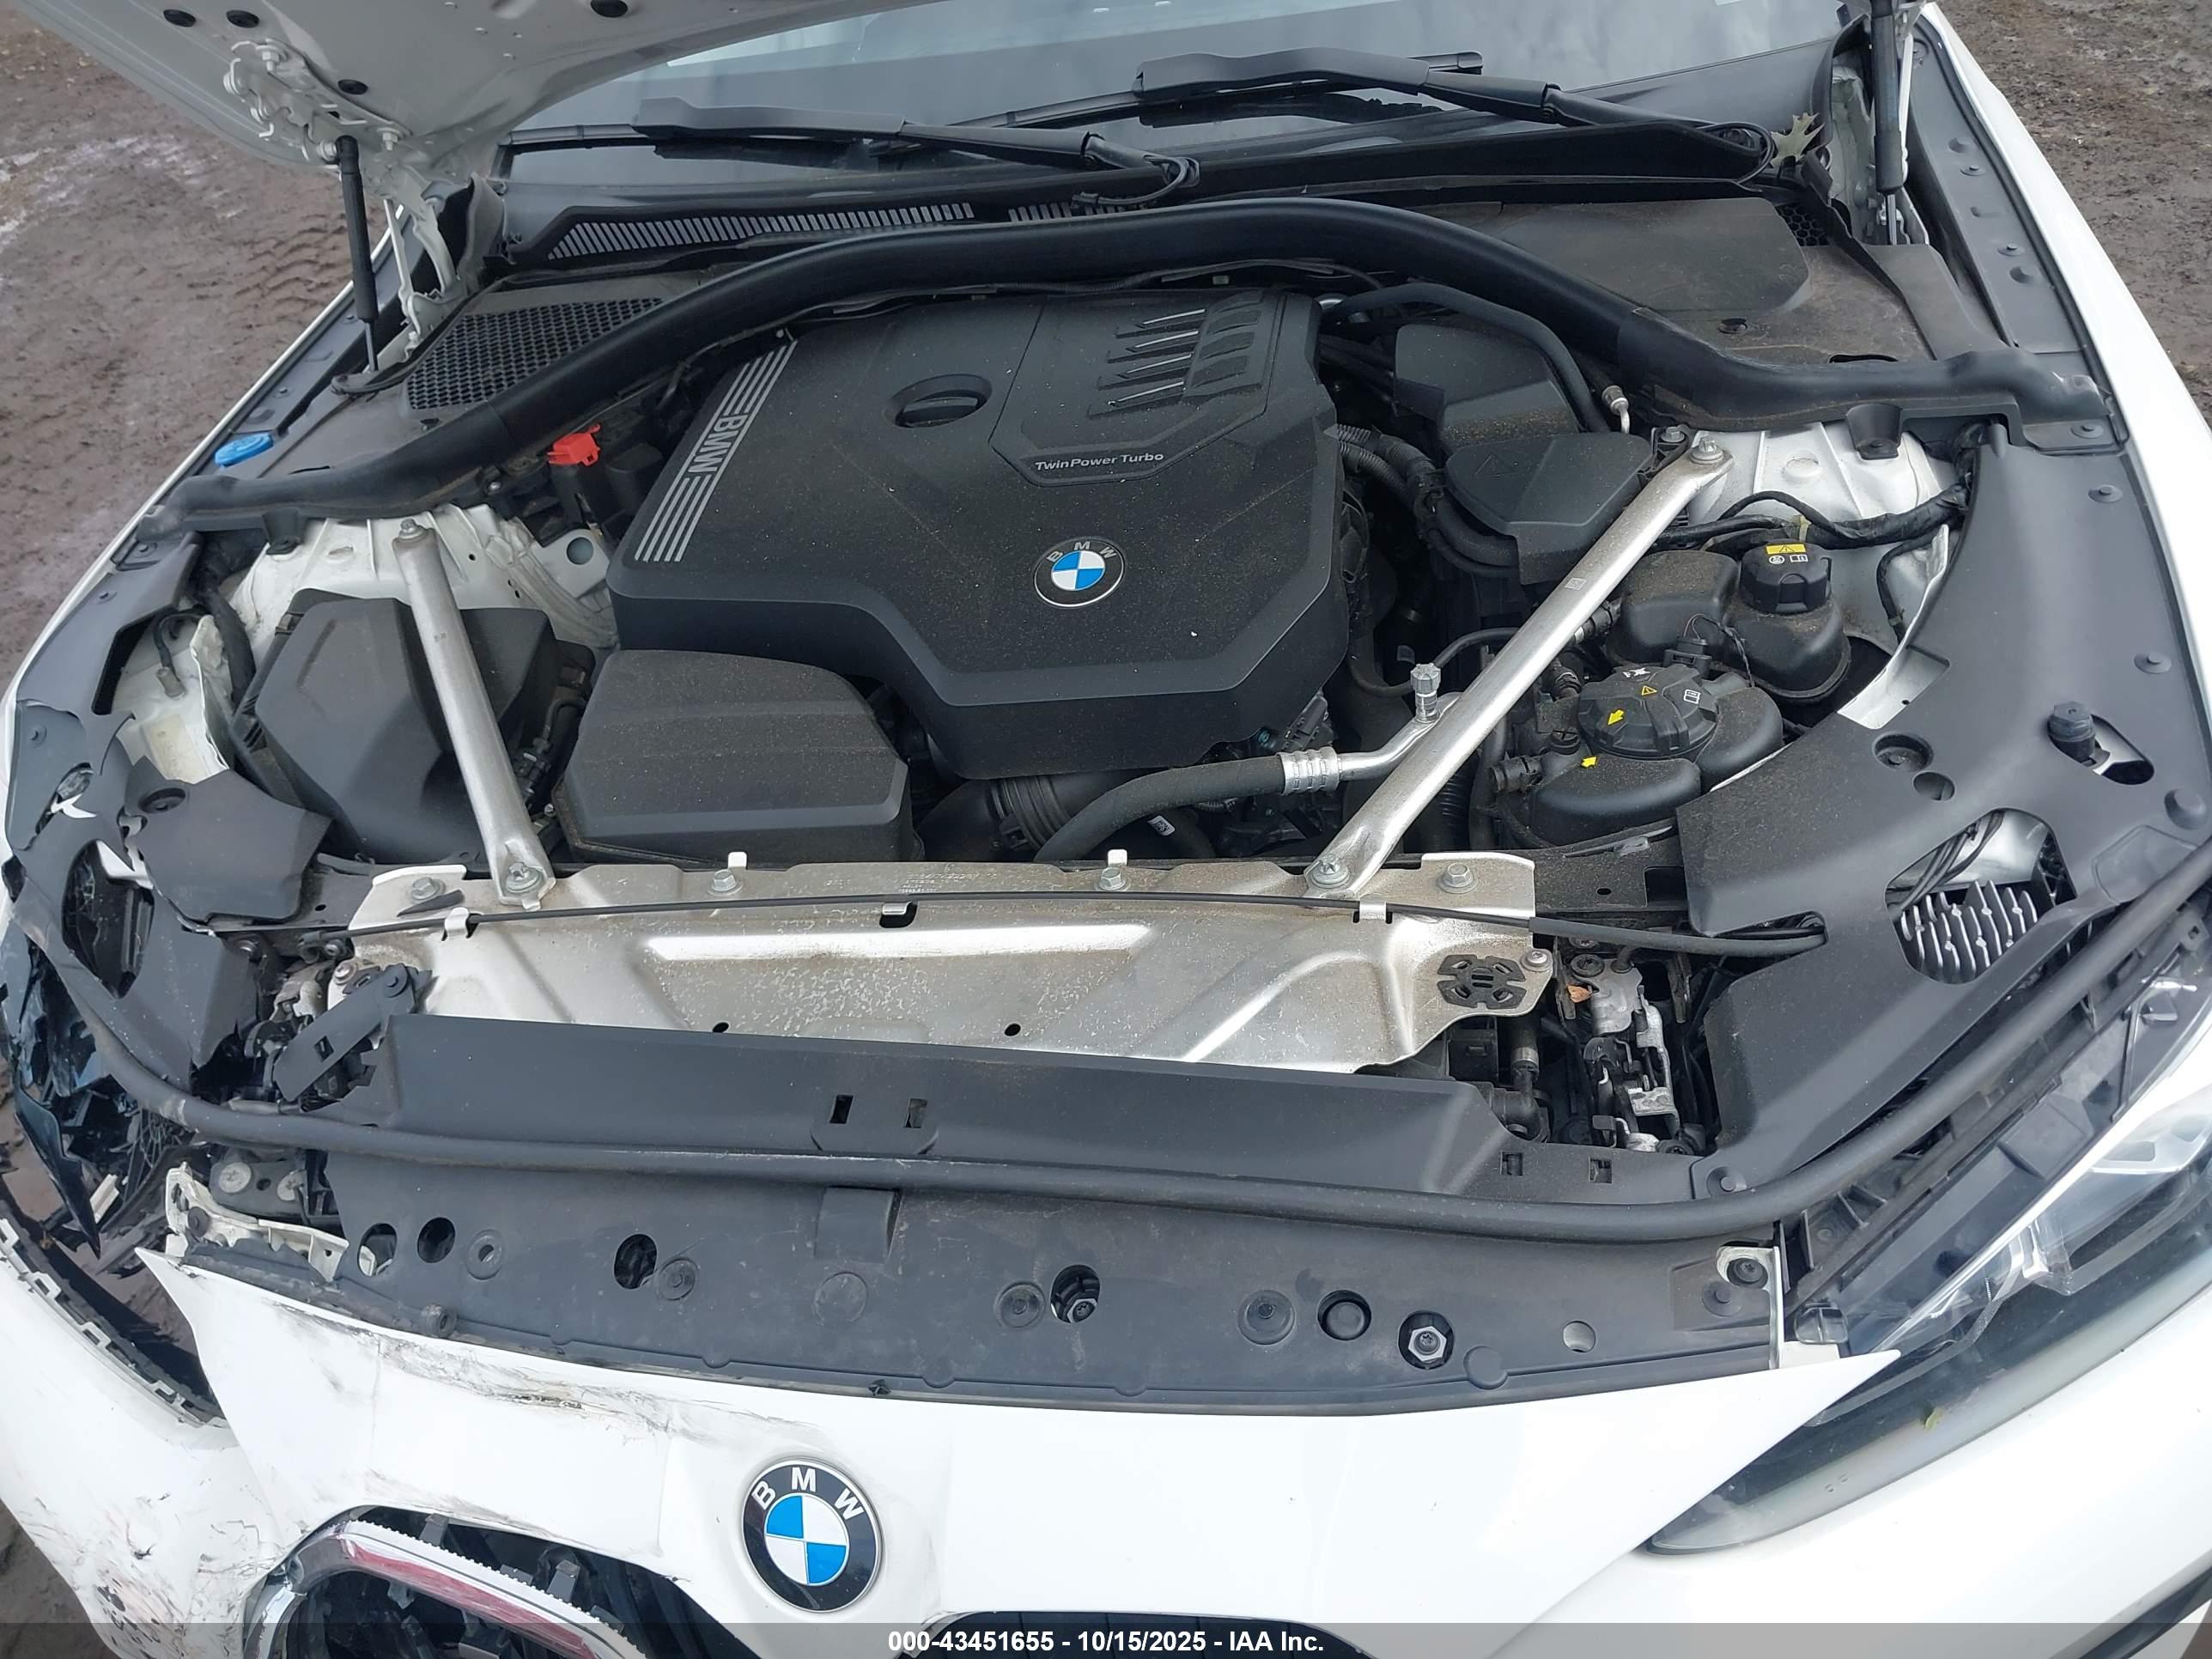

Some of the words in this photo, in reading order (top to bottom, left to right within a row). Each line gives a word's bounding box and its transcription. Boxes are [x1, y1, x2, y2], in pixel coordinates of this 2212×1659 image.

[688, 414, 749, 472] BMW
[1035, 457, 1117, 471] TwinPower
[1120, 453, 1164, 463] Turbo
[1046, 541, 1117, 562] BMW
[751, 1467, 865, 1521] BMW
